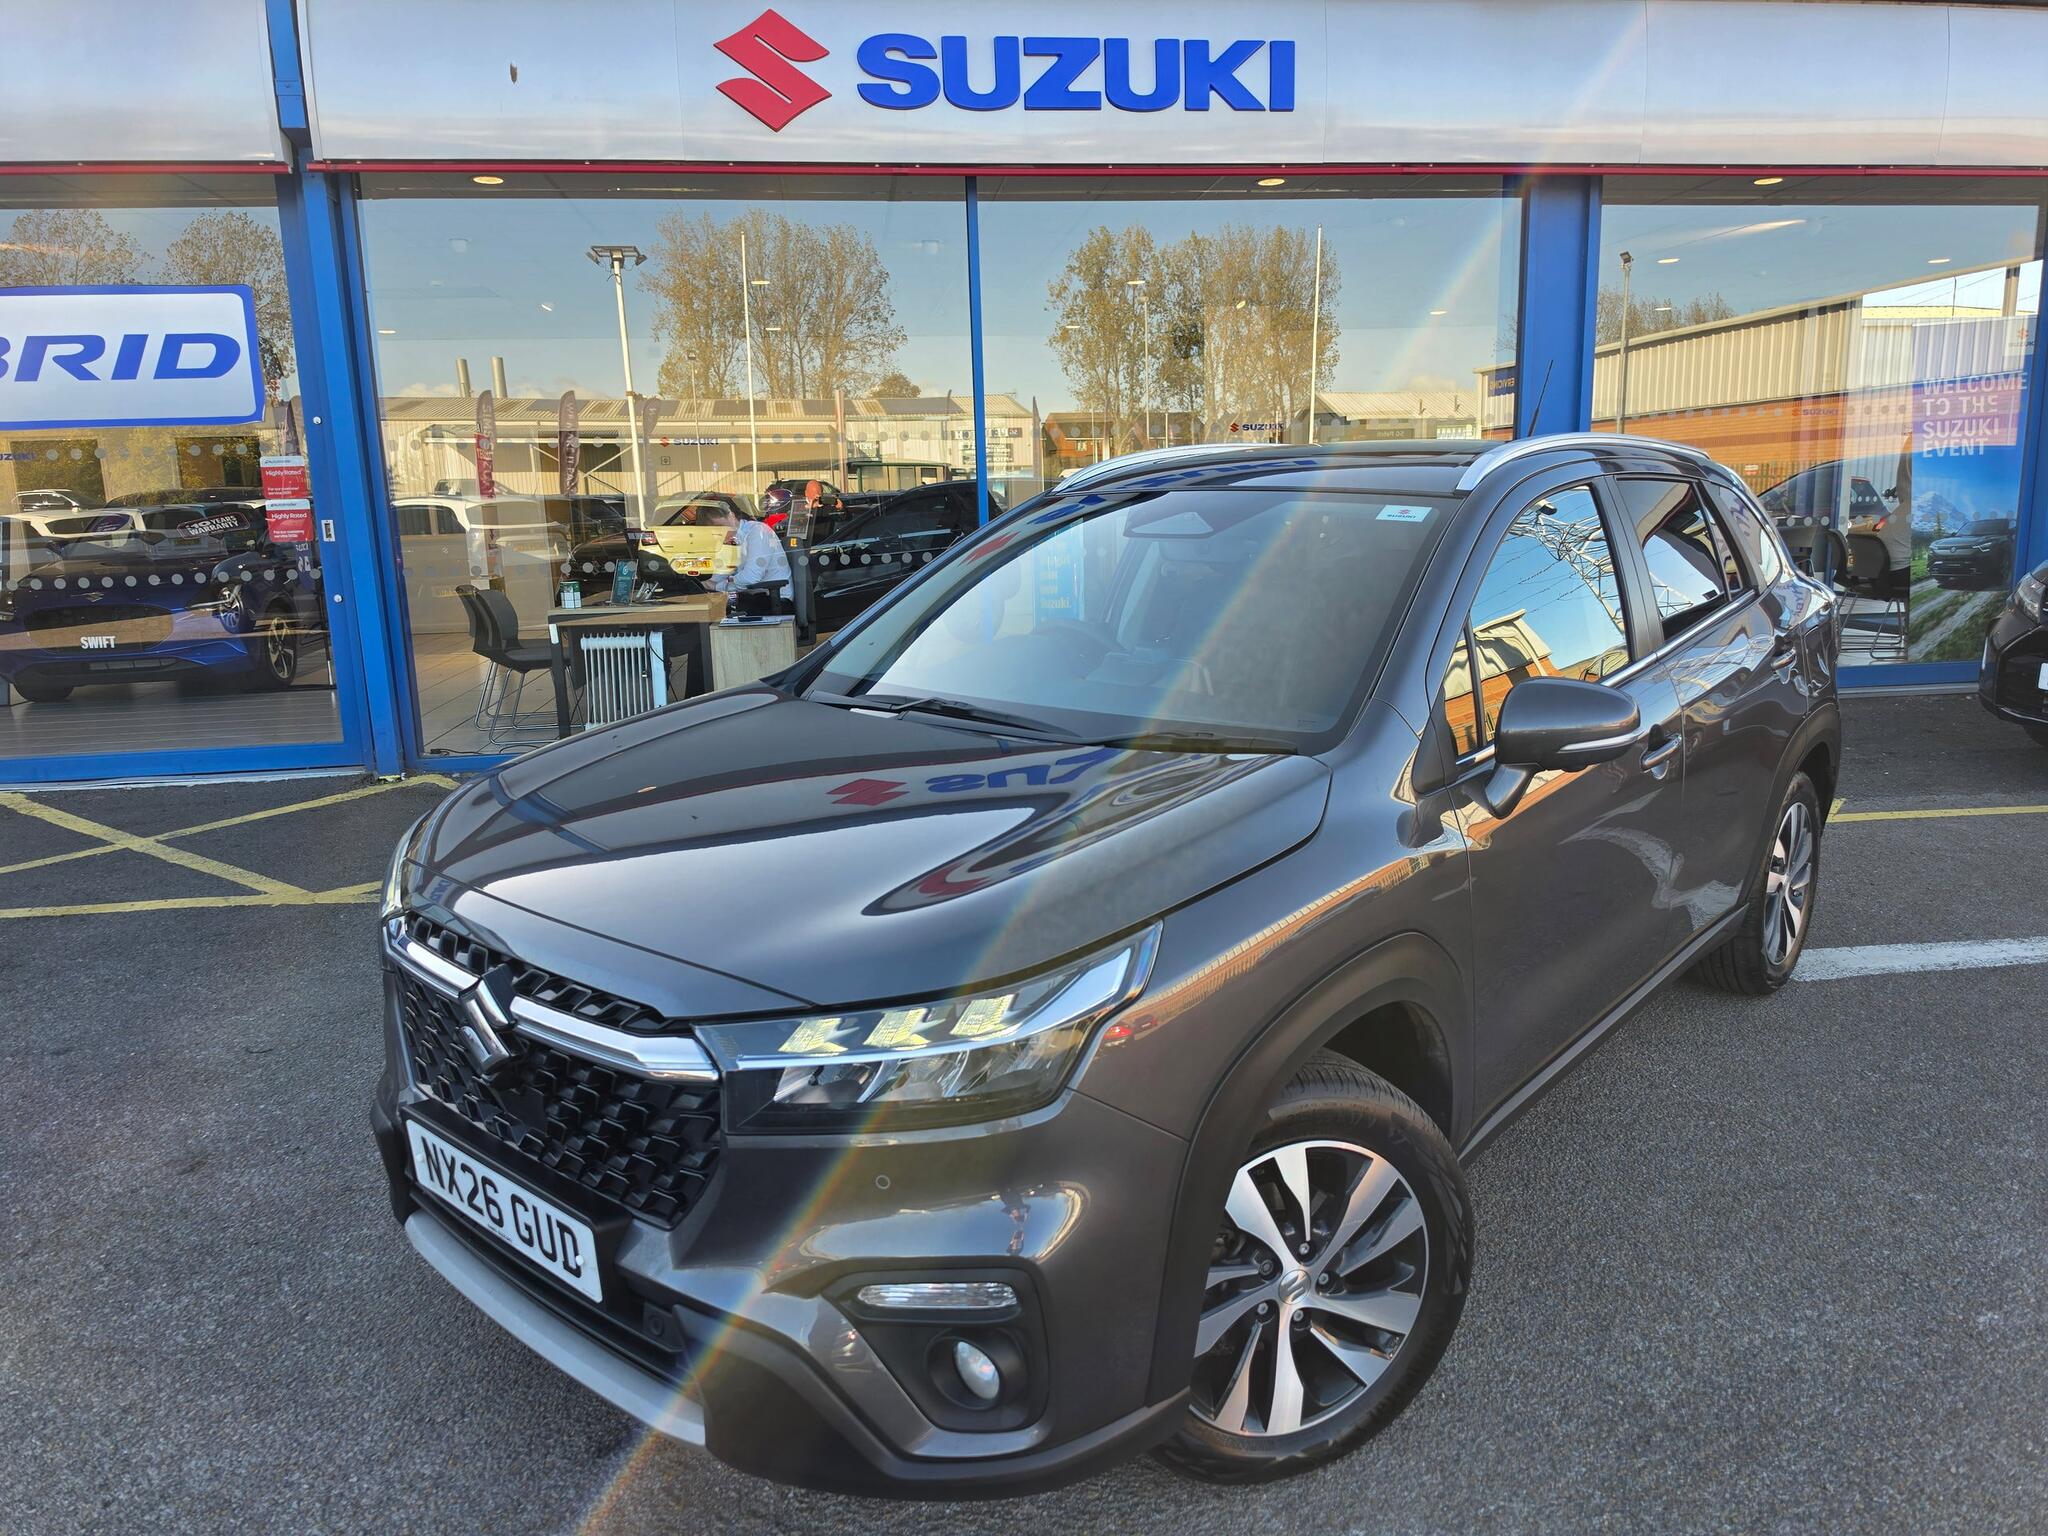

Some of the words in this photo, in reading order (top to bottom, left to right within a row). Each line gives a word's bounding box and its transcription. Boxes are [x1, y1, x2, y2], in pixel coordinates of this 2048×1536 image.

[857, 33, 1296, 112] SUZUKI
[0, 332, 241, 382] RID
[1922, 372, 2028, 396] WELCOME
[1922, 397, 1951, 416] TO
[1958, 394, 1999, 415] THE
[1922, 416, 2000, 439] SUZUKI
[673, 437, 719, 446] SUZUKI
[1922, 437, 1988, 458] EVENT
[188, 520, 240, 536] WARRANTY
[210, 515, 237, 525] YEARS
[80, 635, 116, 650] SWIFT
[421, 1136, 505, 1229] NX26
[510, 1192, 584, 1279] GUD
